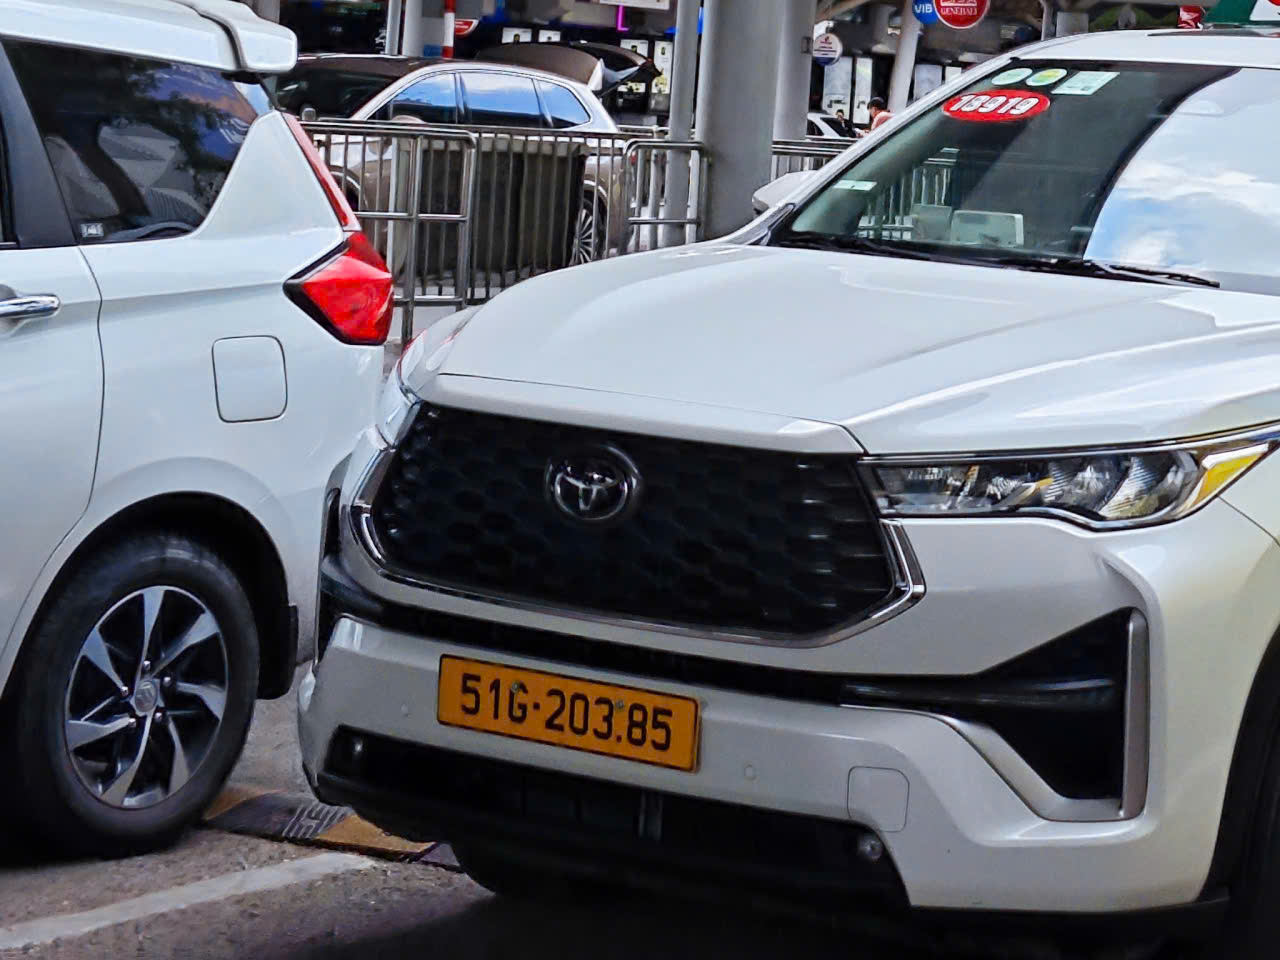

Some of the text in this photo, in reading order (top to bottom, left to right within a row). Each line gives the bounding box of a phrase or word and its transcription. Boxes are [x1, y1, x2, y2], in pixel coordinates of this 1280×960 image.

[914, 3, 933, 14] VIB
[940, 5, 978, 16] GENERALI
[950, 94, 1039, 116] 18919
